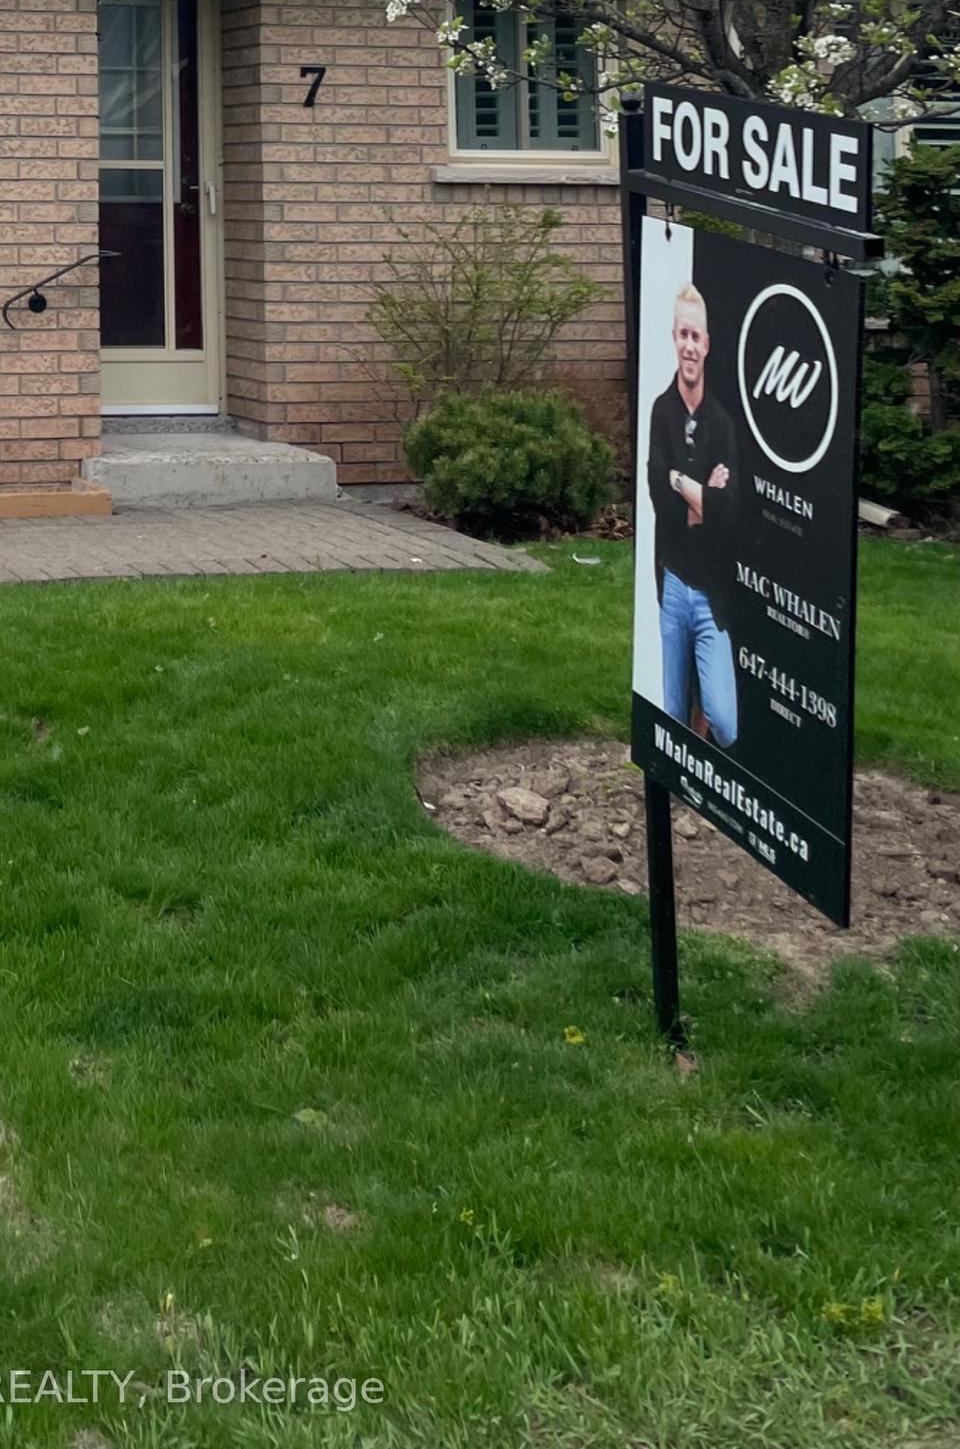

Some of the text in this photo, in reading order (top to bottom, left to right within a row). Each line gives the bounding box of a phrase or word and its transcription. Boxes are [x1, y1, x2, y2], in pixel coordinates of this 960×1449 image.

[300, 66, 327, 108] 7
[652, 95, 859, 214] FOR SALE
[753, 474, 814, 521] WHALEN
[735, 560, 841, 642] MAC WHALEN
[738, 645, 838, 729] 647-444-1398
[653, 722, 810, 863] WhalenRealEstate.ca
